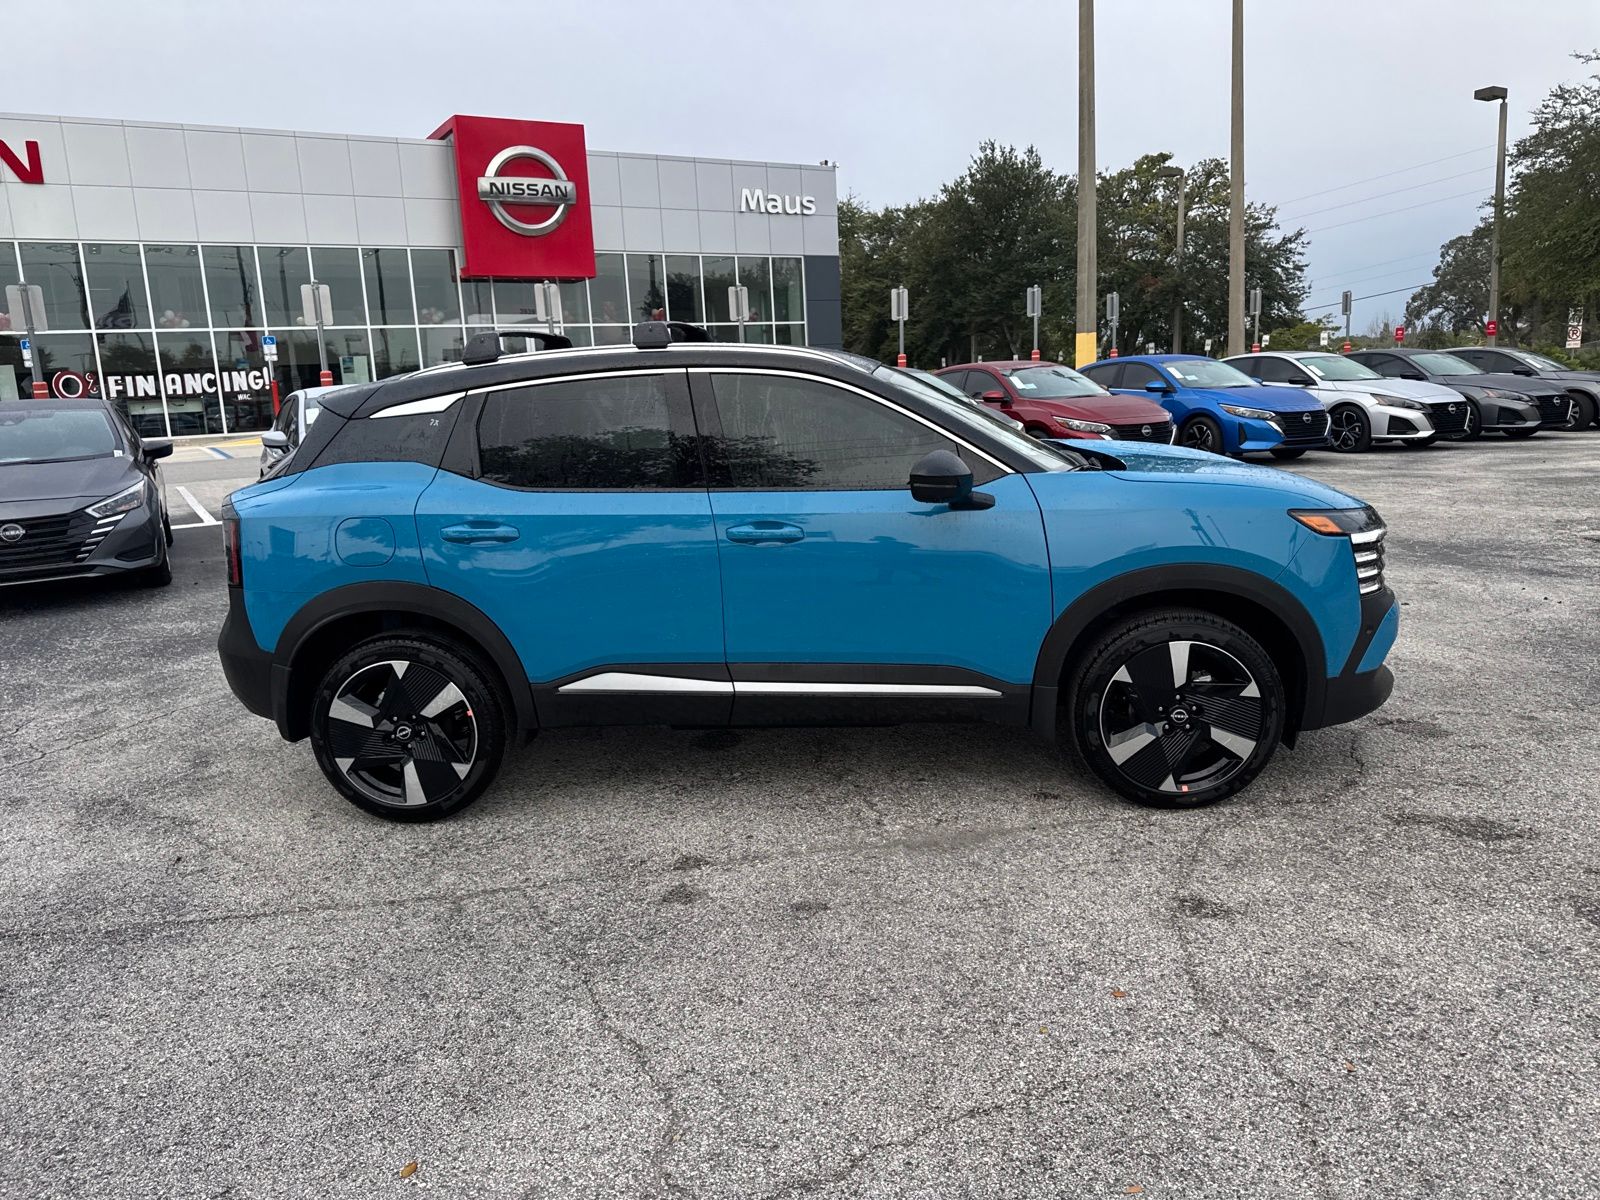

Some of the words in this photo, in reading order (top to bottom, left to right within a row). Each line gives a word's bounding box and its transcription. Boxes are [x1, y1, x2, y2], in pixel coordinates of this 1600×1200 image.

[489, 182, 568, 198] NISSAN
[740, 188, 817, 216] Maus
[107, 366, 270, 400] FINANCING!
